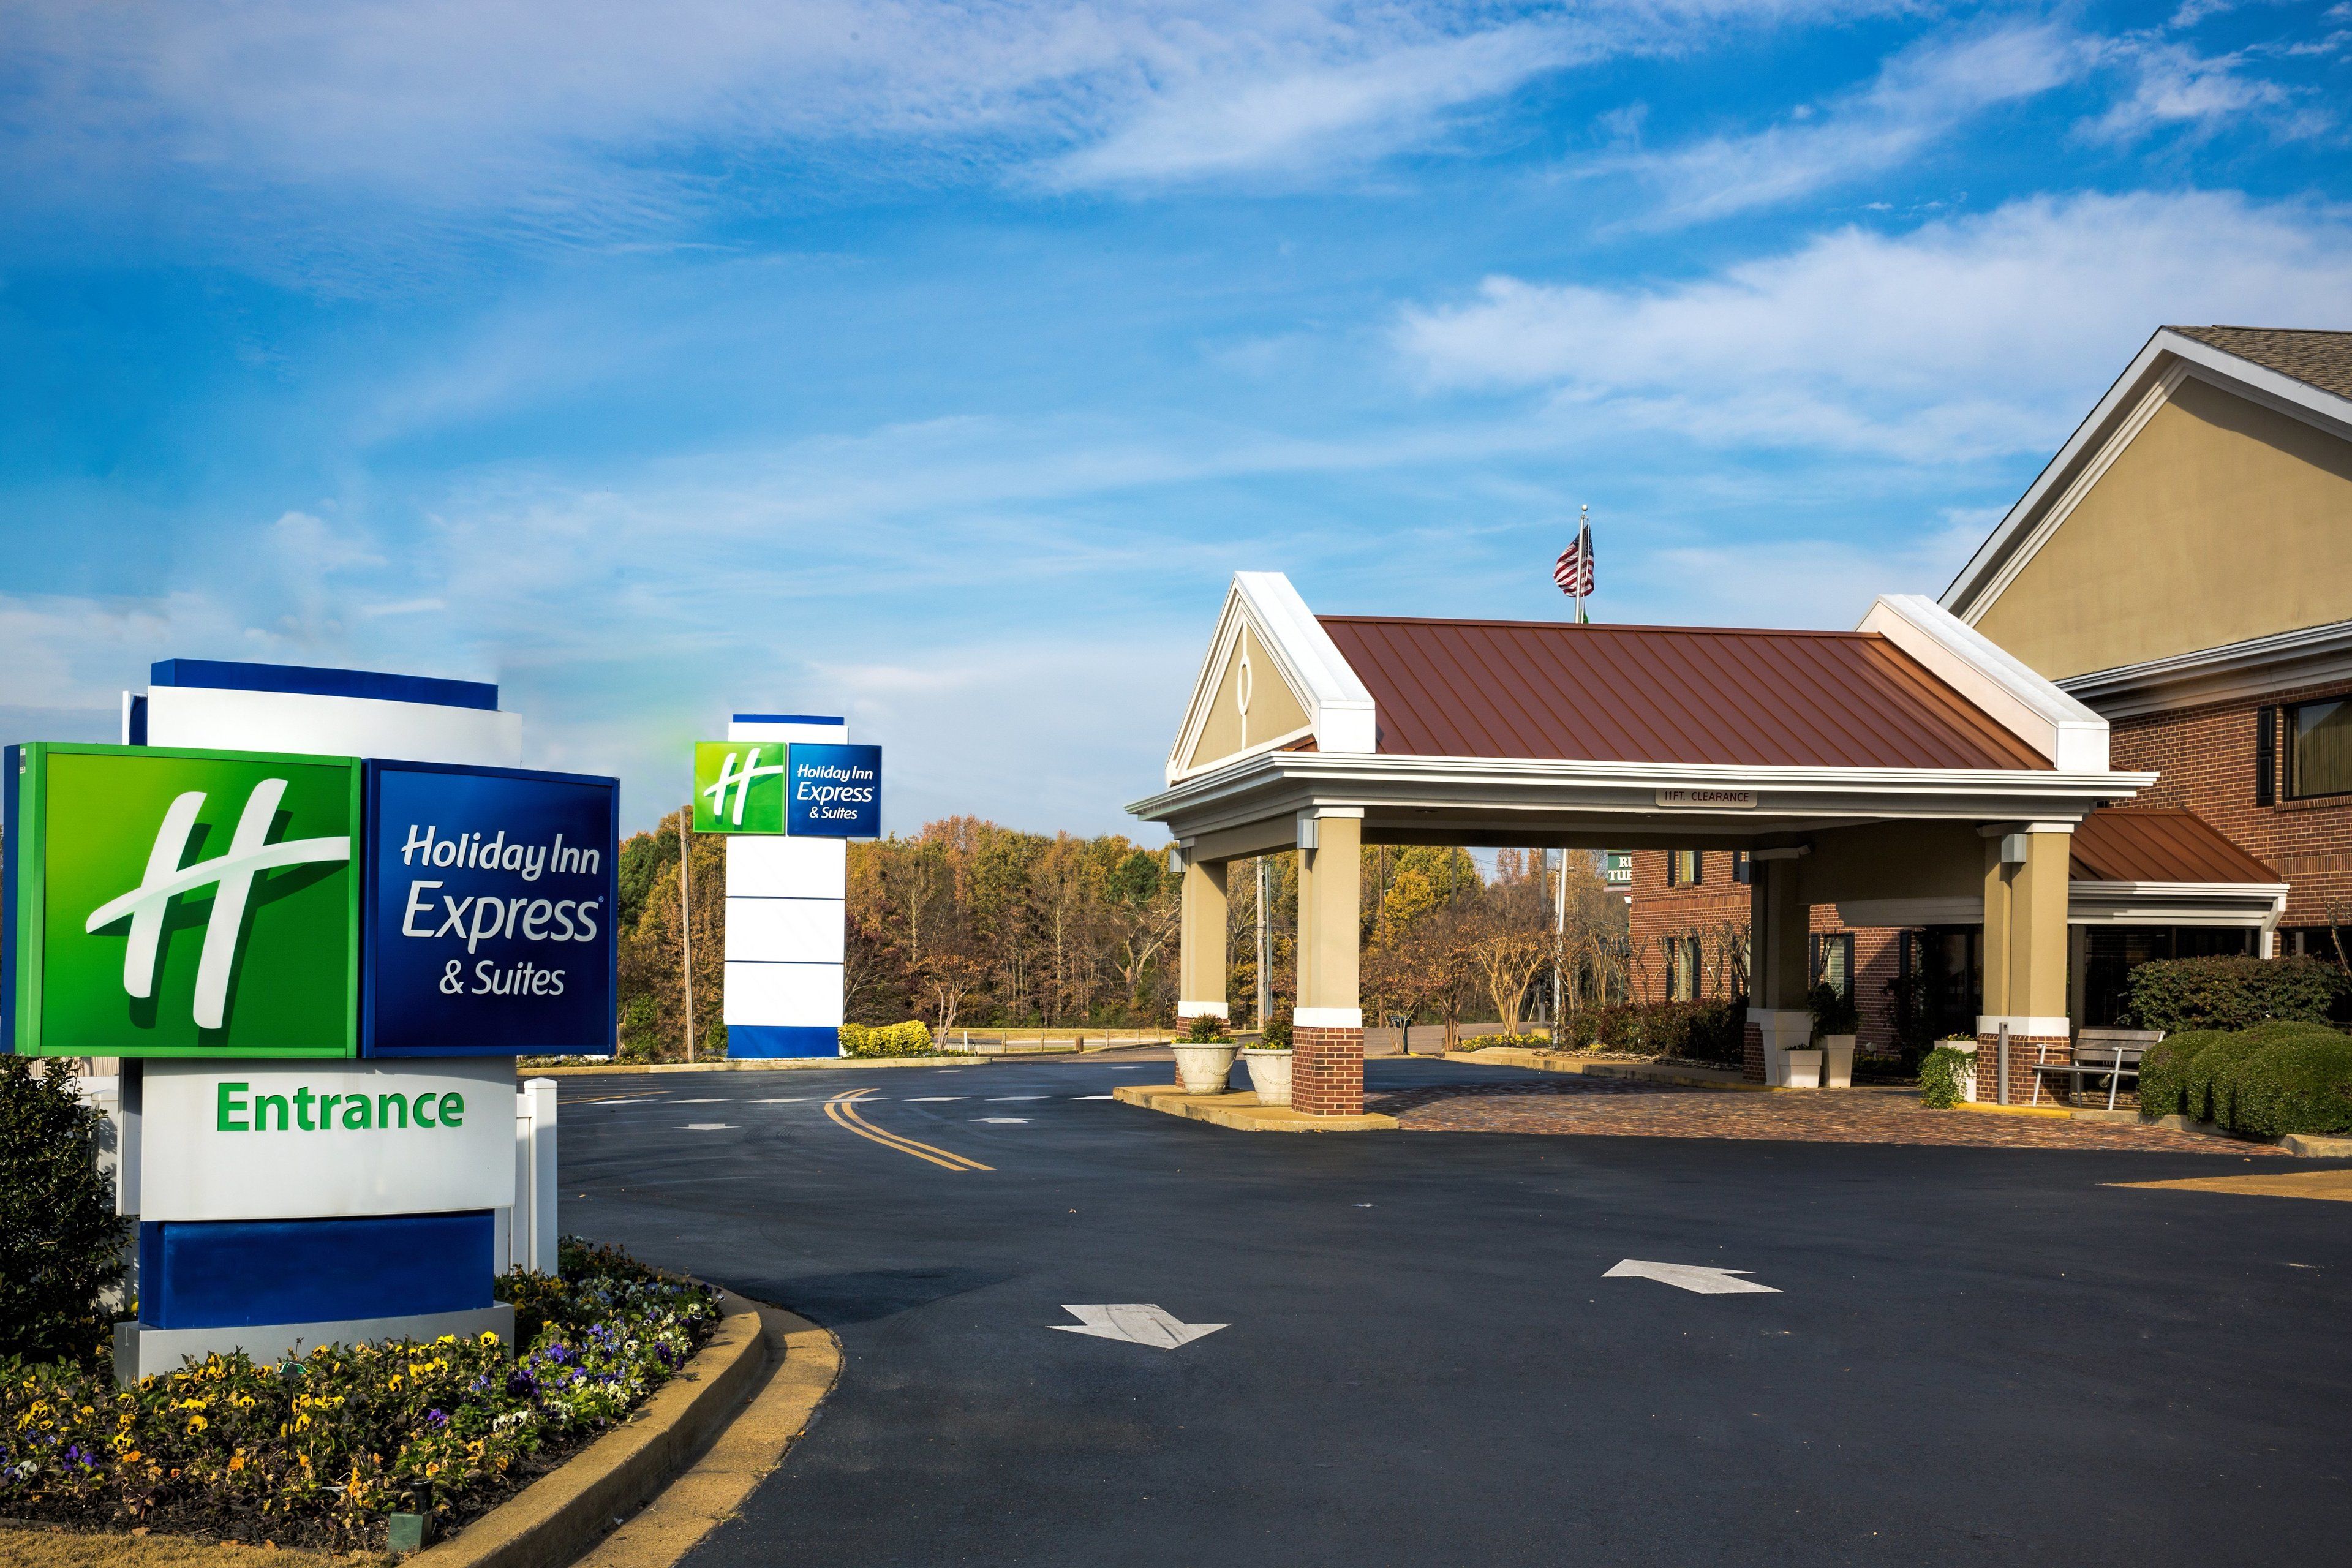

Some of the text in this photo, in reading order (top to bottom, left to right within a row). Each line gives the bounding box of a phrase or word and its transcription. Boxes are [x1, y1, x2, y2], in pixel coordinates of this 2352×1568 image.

[796, 763, 873, 782] Holiday Inn
[797, 781, 873, 806] Express
[1691, 791, 1749, 802] CLEARANCE
[809, 806, 858, 820] & Suites
[401, 824, 600, 882] Holiday Inn
[439, 959, 565, 995] & Suites
[217, 1082, 466, 1132] Entrance
